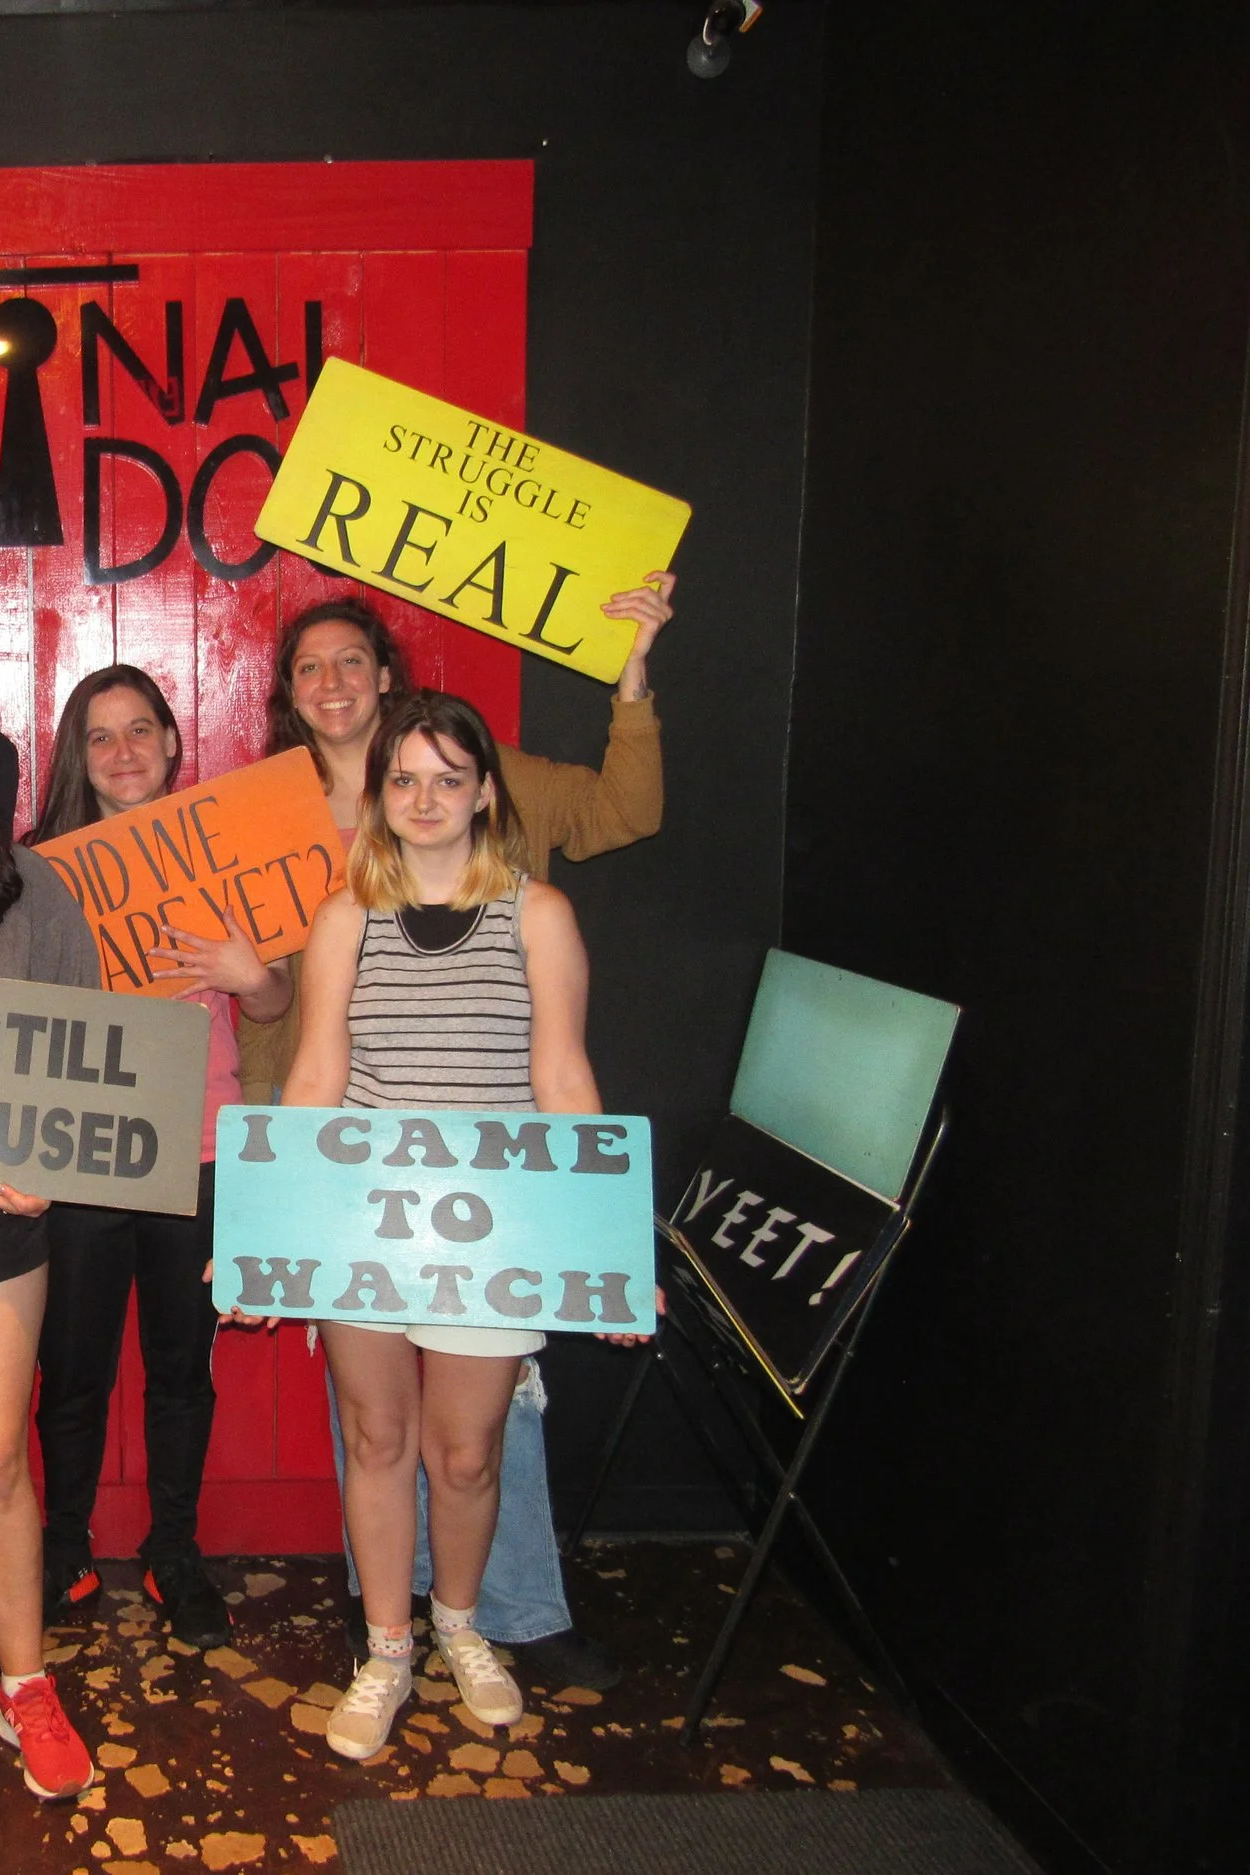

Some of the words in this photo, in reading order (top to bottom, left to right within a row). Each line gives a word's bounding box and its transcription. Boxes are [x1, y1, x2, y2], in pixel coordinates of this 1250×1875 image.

[382, 424, 591, 530] STRUGGLE
[467, 420, 541, 473] THE
[456, 489, 495, 524] IS
[296, 468, 585, 656] REAL
[129, 795, 239, 893] WE
[198, 843, 333, 945] YET?
[238, 1114, 277, 1163] I
[316, 1116, 631, 1175] CAME
[367, 1189, 494, 1243] TO
[683, 1169, 862, 1306] YEET!
[232, 1256, 638, 1324] WATCH
